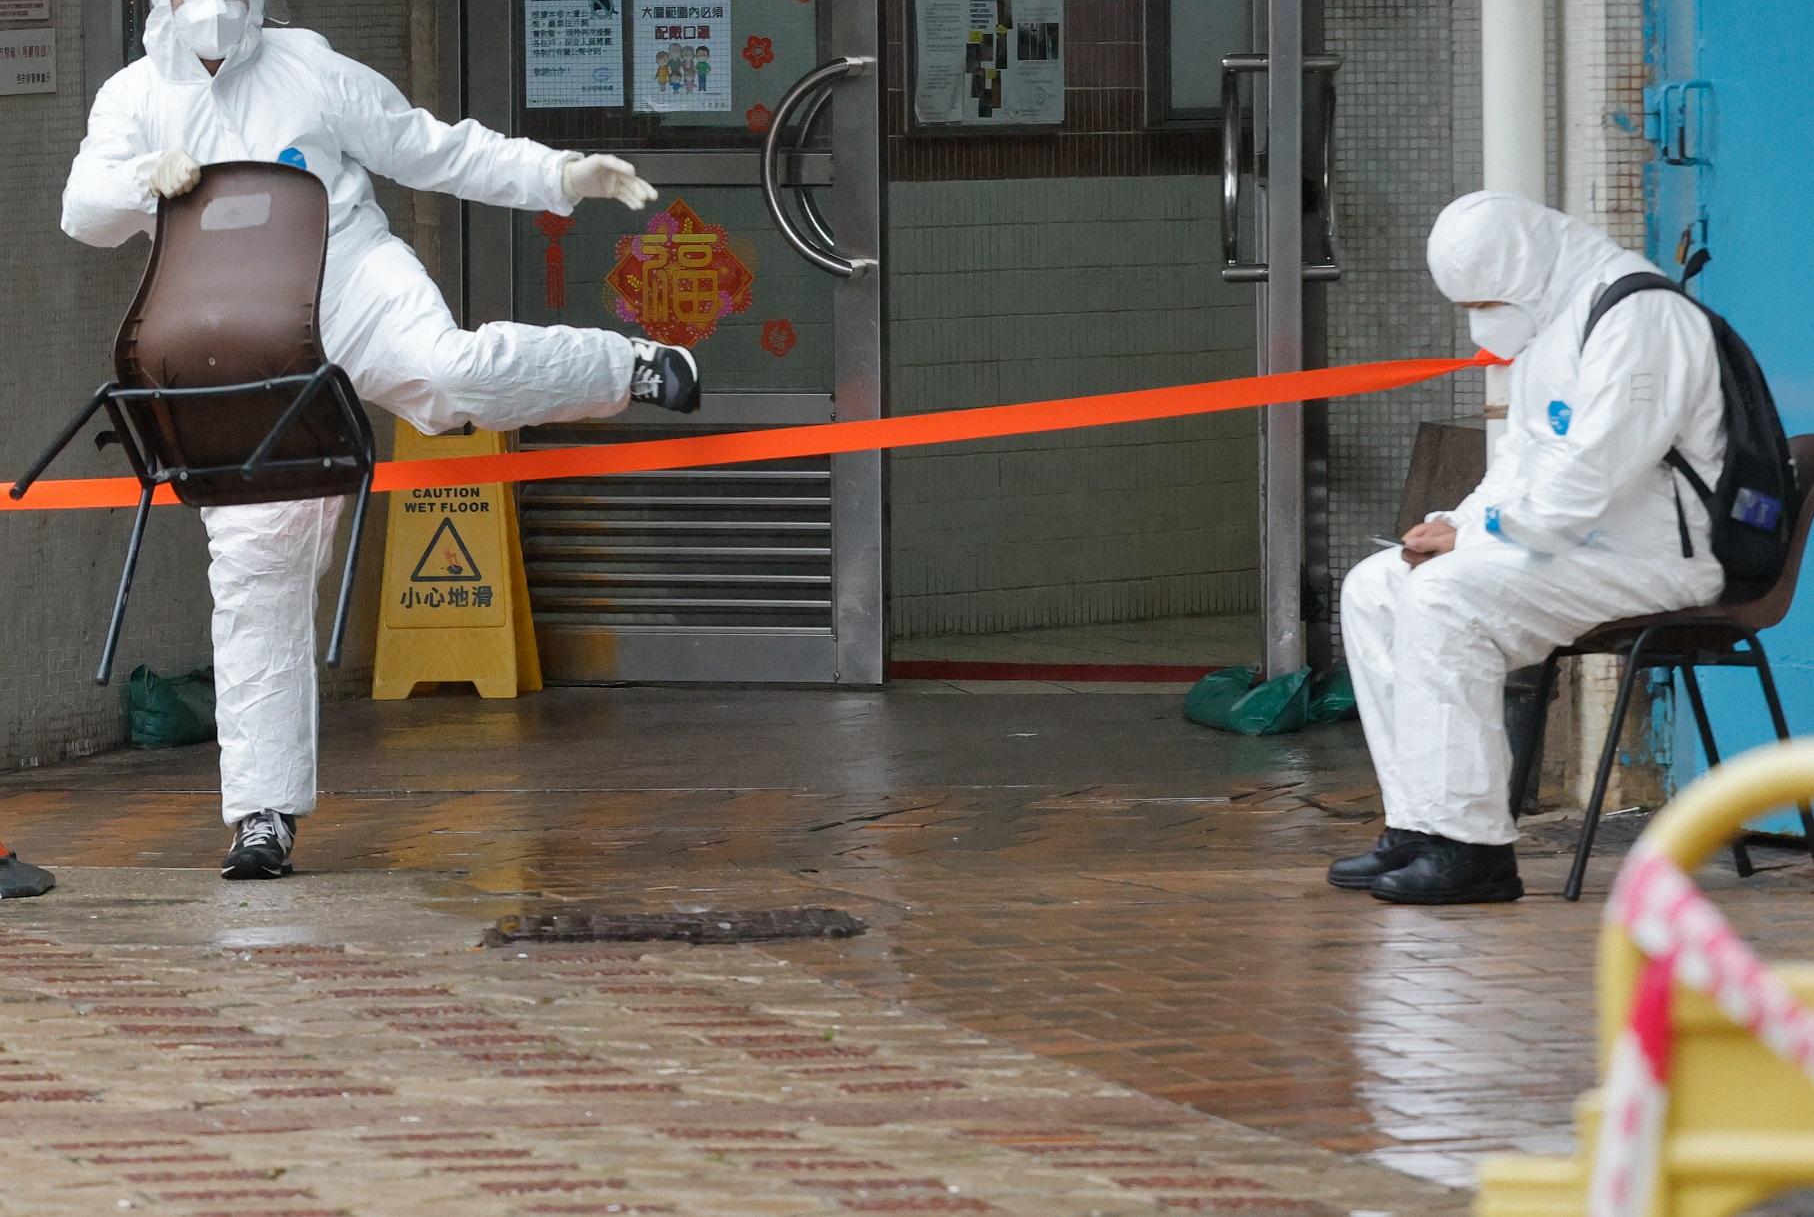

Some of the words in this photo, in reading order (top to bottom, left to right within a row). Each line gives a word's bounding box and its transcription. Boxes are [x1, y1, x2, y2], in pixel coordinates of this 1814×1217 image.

[641, 234, 718, 323] 福
[412, 487, 480, 498] CAUTION
[405, 503, 436, 512] WET
[440, 502, 489, 512] FLOOR
[400, 586, 493, 608] 小心地滑
